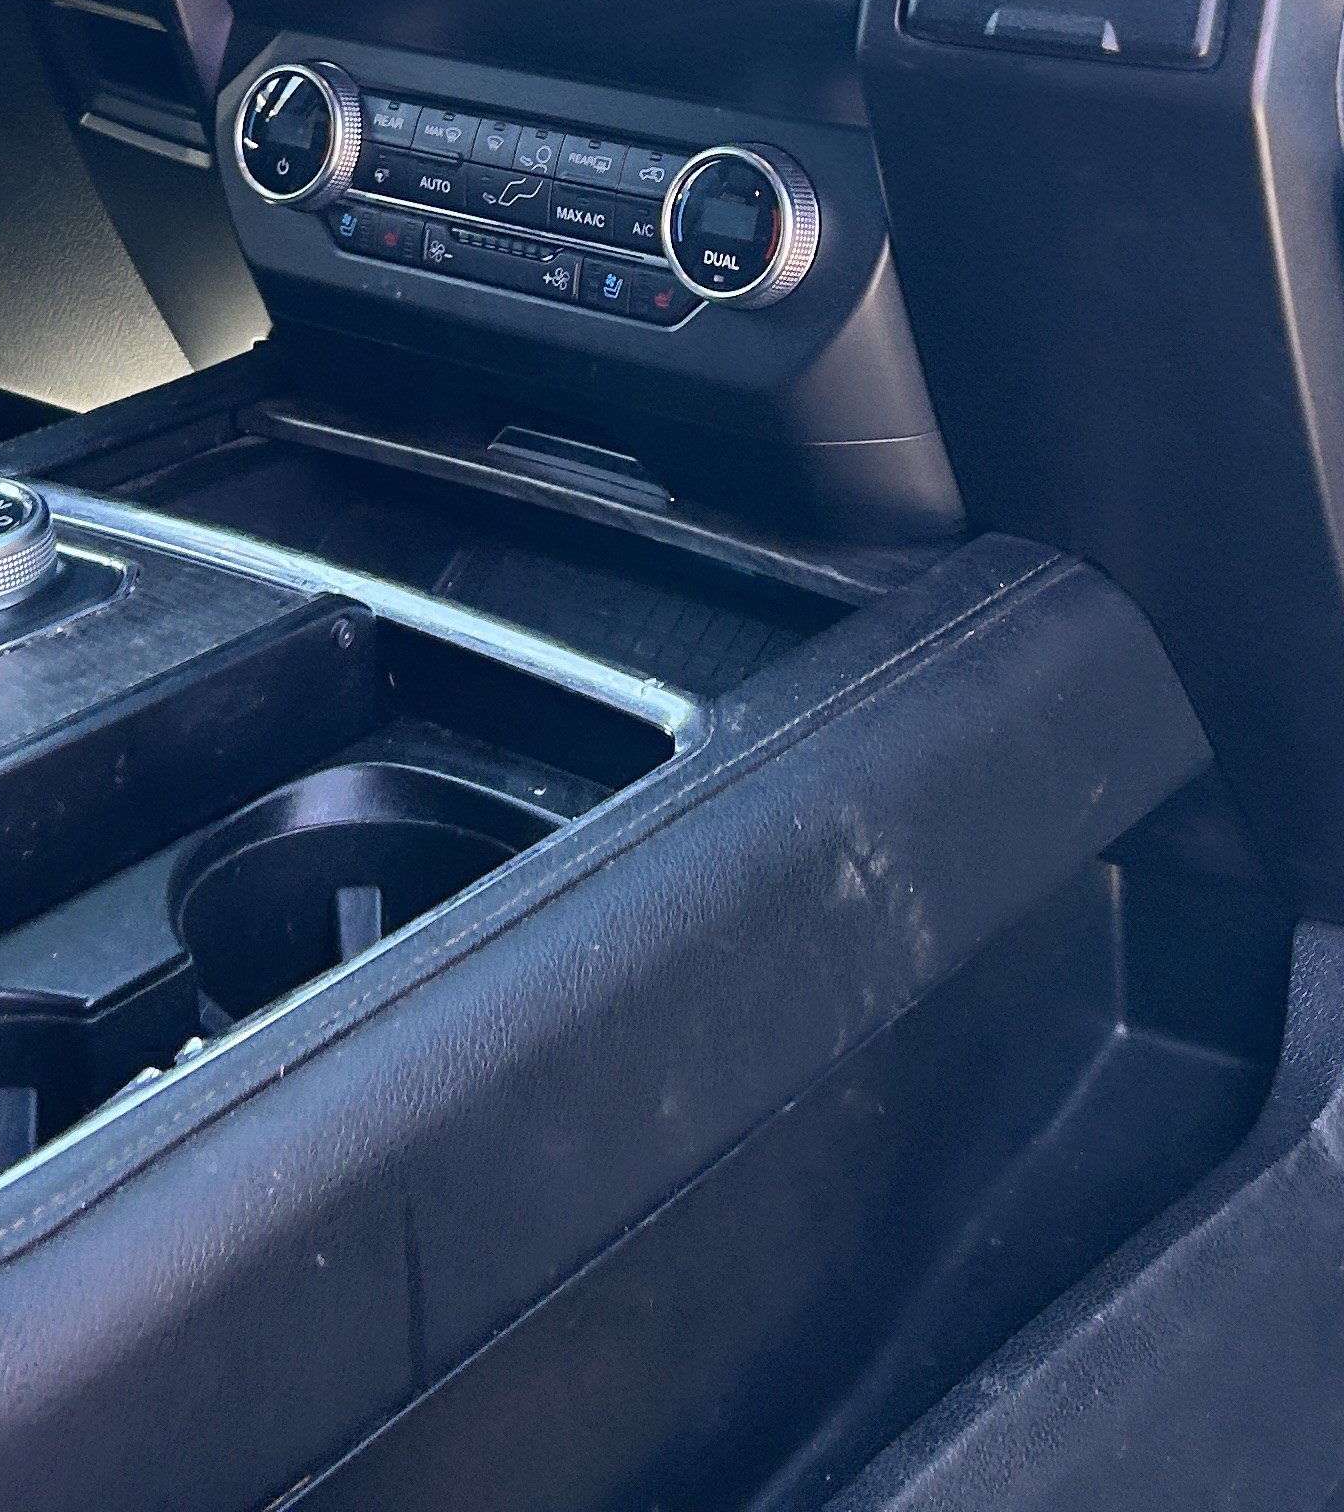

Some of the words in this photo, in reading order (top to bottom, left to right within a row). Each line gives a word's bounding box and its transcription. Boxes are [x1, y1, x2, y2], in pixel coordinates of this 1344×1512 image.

[374, 113, 405, 131] REAR
[424, 125, 445, 138] MAX
[568, 152, 595, 166] REAR
[419, 175, 451, 194] AUTO
[556, 206, 583, 224] MAX
[583, 211, 606, 228] A/C
[632, 221, 655, 238] A/C
[703, 250, 740, 271] DUAL
